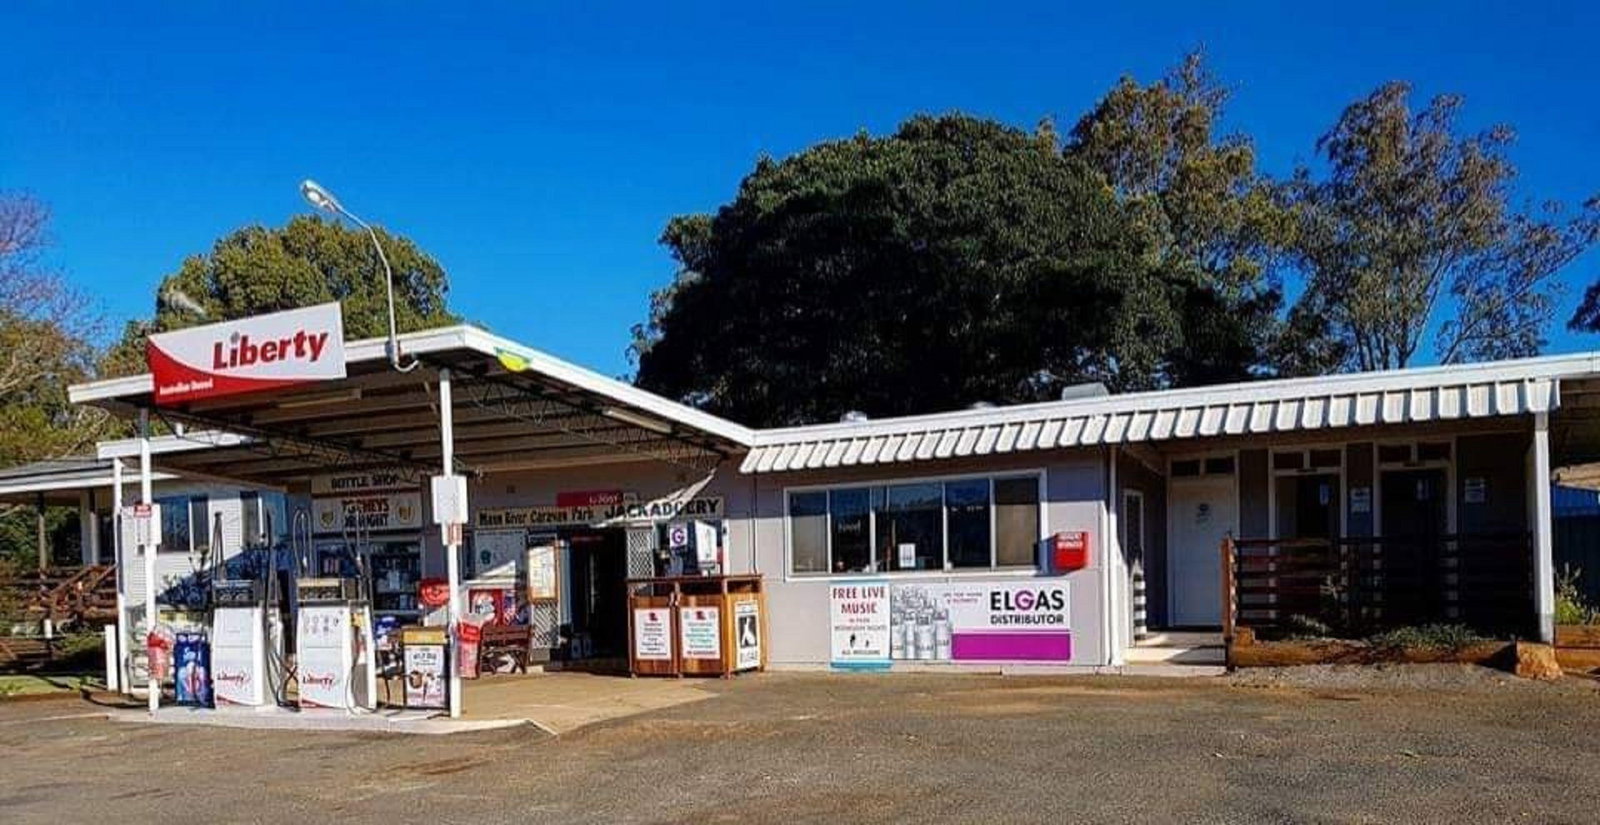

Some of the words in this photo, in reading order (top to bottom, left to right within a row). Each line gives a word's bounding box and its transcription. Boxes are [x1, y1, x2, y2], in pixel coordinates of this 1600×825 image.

[213, 330, 328, 370] Liberty
[371, 473, 400, 486] SHOP
[530, 508, 568, 523] Caravan
[833, 587, 857, 599] FREE
[862, 586, 885, 599] LIVE
[990, 590, 1065, 611] ELGAS
[841, 602, 878, 614] MUSIC
[990, 613, 1065, 625] DISTRIBUTOR
